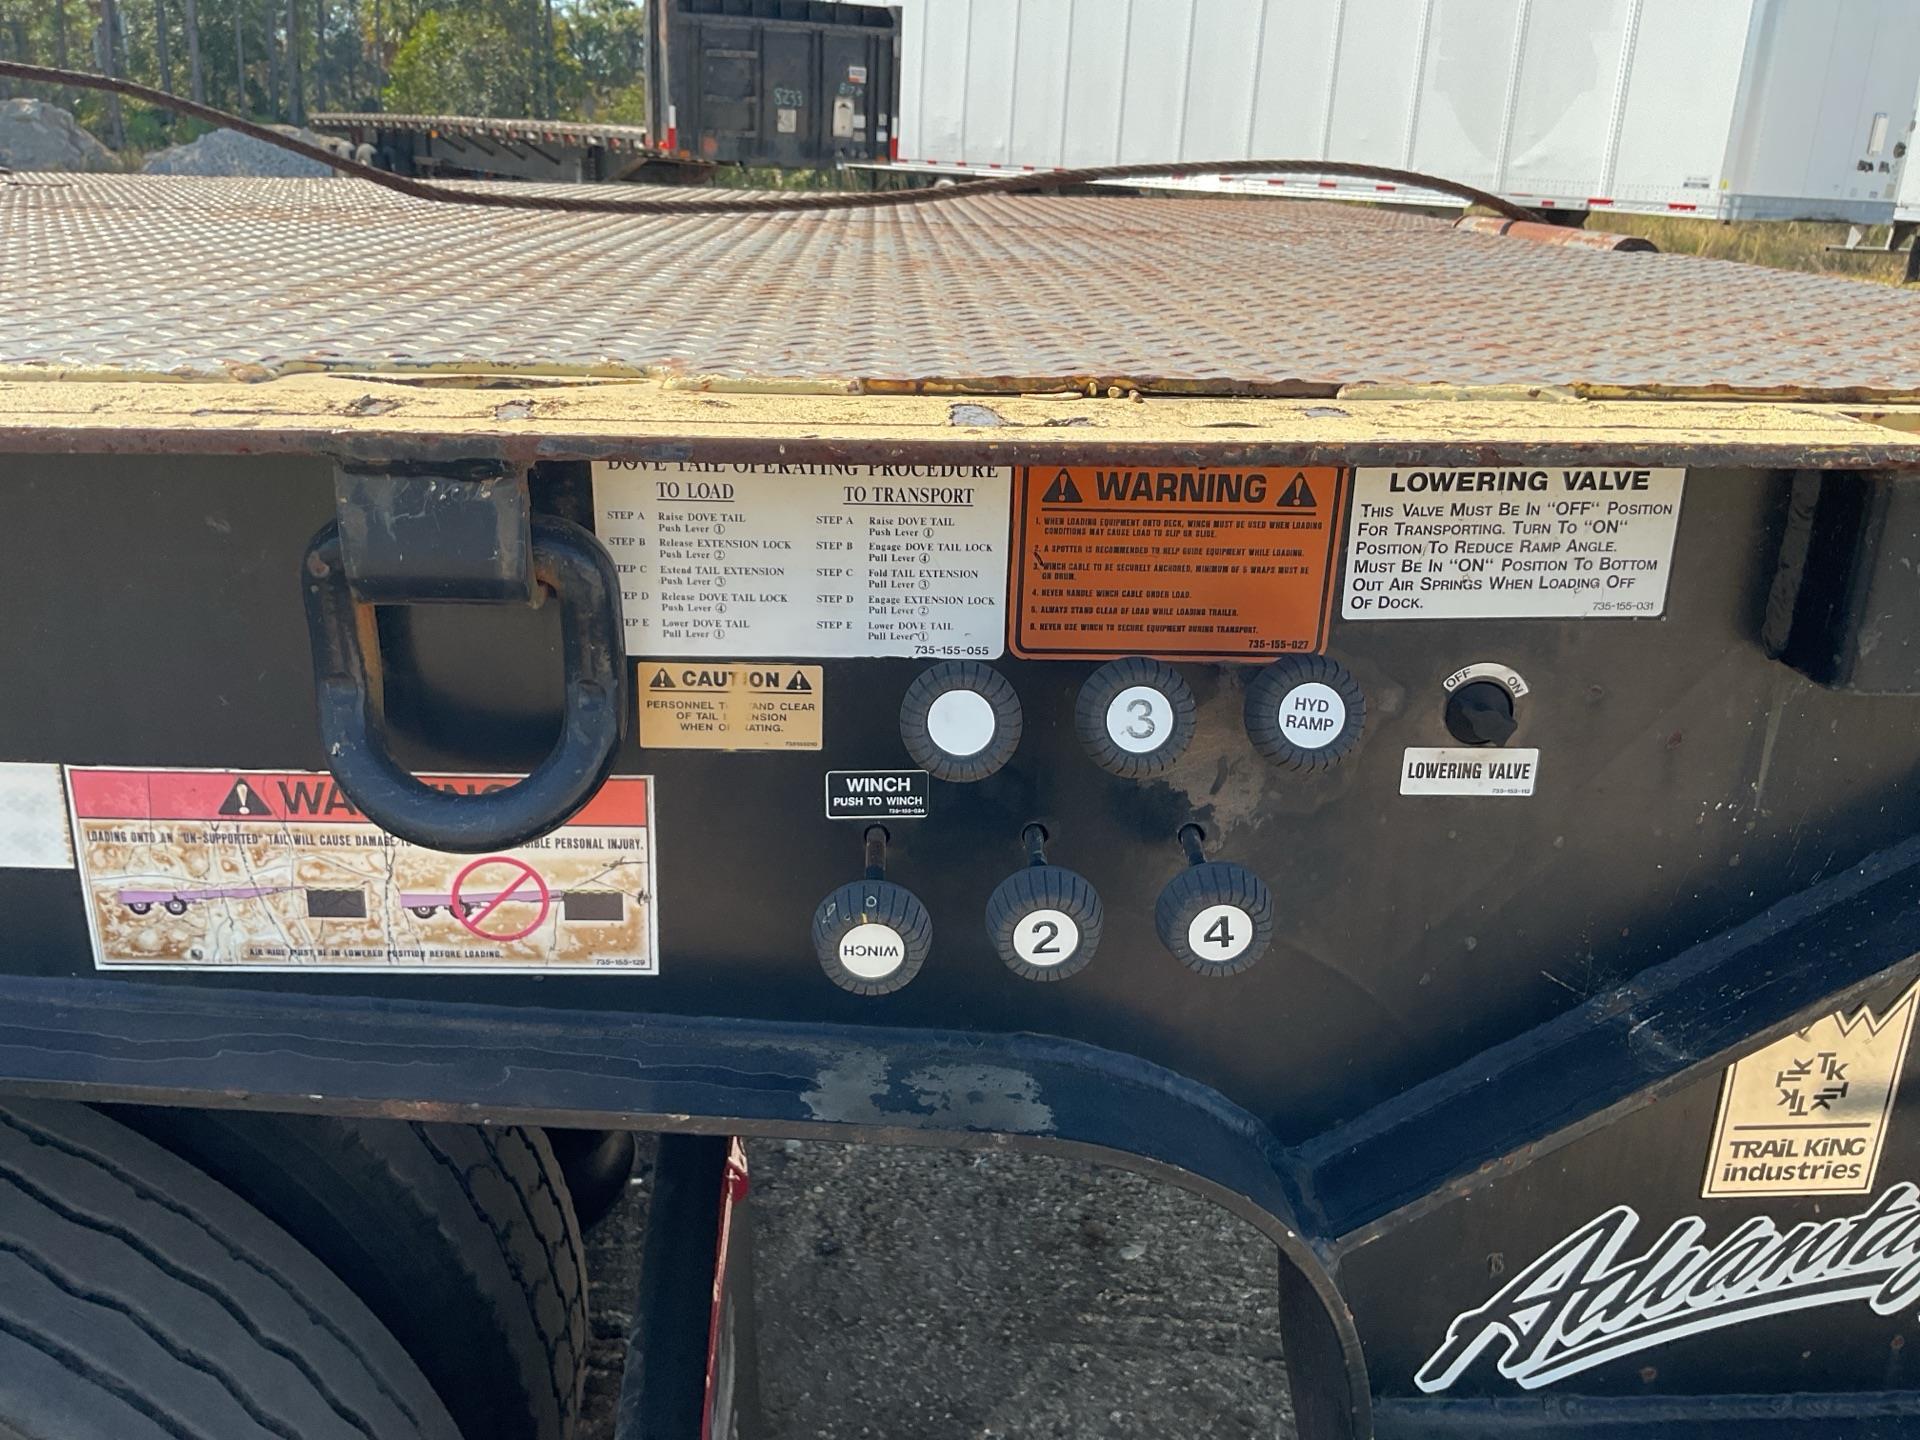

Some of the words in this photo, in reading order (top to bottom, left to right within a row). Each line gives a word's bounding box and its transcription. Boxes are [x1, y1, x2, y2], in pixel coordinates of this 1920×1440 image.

[608, 460, 666, 471] DOVE
[867, 465, 998, 478] PROCEDURE
[1390, 471, 1548, 492] LOWERING
[1563, 470, 1650, 491] VALVE
[656, 482, 679, 498] TO
[688, 483, 734, 499] LOAD
[1096, 471, 1267, 503] WARNING
[844, 486, 866, 502] TO
[872, 487, 974, 503] TRANSPORT
[607, 511, 633, 520] STEP
[637, 512, 645, 520] A
[658, 512, 683, 521] Raise
[687, 513, 717, 522] DOVE
[720, 513, 746, 522] TAIL
[816, 515, 842, 524] STEP
[846, 516, 853, 525] A
[869, 517, 893, 525] Raise
[898, 517, 927, 526] DOVE
[930, 517, 955, 526] TAIL
[658, 524, 681, 532] Push
[685, 524, 709, 533] Lever
[869, 528, 891, 537] Push
[895, 528, 919, 537] Lever
[608, 537, 634, 546] STEP
[639, 538, 646, 546] B
[659, 539, 693, 548] Release
[697, 539, 758, 549] EXTENSION
[763, 540, 792, 549] LOCK
[816, 541, 842, 550] STEP
[847, 542, 853, 550] B
[869, 542, 901, 552] Engage
[905, 543, 934, 552] DOVE
[938, 543, 961, 552] TAIL
[965, 543, 993, 552] LOCK
[659, 550, 682, 559] Push
[686, 551, 709, 559] Lever
[869, 554, 888, 562] Pull
[891, 554, 915, 563] Lever
[816, 568, 842, 577] STEP
[846, 569, 854, 577] C
[868, 569, 888, 578] Fold
[891, 569, 915, 578] TAIL
[919, 570, 978, 579] EXTENSION
[868, 580, 887, 589] Pull
[891, 580, 914, 589] Lever
[1096, 590, 1118, 598] WINCH
[816, 595, 842, 604] STEP
[846, 595, 854, 604] D
[868, 596, 900, 605] Engage
[904, 596, 963, 605] EXTENSION
[968, 596, 995, 606] LOCK
[868, 606, 887, 615] Pull
[891, 607, 914, 615] Lever
[1592, 602, 1654, 610] 735-155-031
[1248, 639, 1309, 649] 735-155-027
[914, 645, 989, 655] 735-155-055
[1446, 668, 1472, 688] OFF
[1506, 676, 1524, 694] ON
[646, 700, 714, 710] PERSONNEL
[780, 702, 816, 711] CLEAR
[1294, 696, 1329, 713] HYD
[676, 711, 693, 720] OF
[695, 711, 718, 720] TAIL
[1125, 698, 1155, 739] 3
[680, 723, 713, 731] WHEN
[1285, 714, 1334, 732] RAMP
[1408, 762, 1482, 779] LOWERING
[1488, 763, 1531, 780] VALVE
[846, 777, 911, 792] WINCH
[833, 796, 864, 807] PUSH
[867, 796, 882, 806] TO
[886, 796, 922, 805] WINCH
[87, 830, 127, 842] LOADING
[130, 831, 155, 843] ONTO
[268, 833, 290, 845] TAIL
[293, 834, 316, 846] WILL
[319, 834, 351, 846] CAUSE
[555, 838, 604, 849] PERSONAL
[607, 838, 644, 850] INJURY.
[1203, 915, 1234, 948] 4
[1032, 920, 1060, 954] 2
[429, 950, 461, 958] BEFORE
[465, 950, 504, 958] LOADING.
[843, 944, 899, 957] WINCH
[1722, 1161, 1862, 1182] industries
